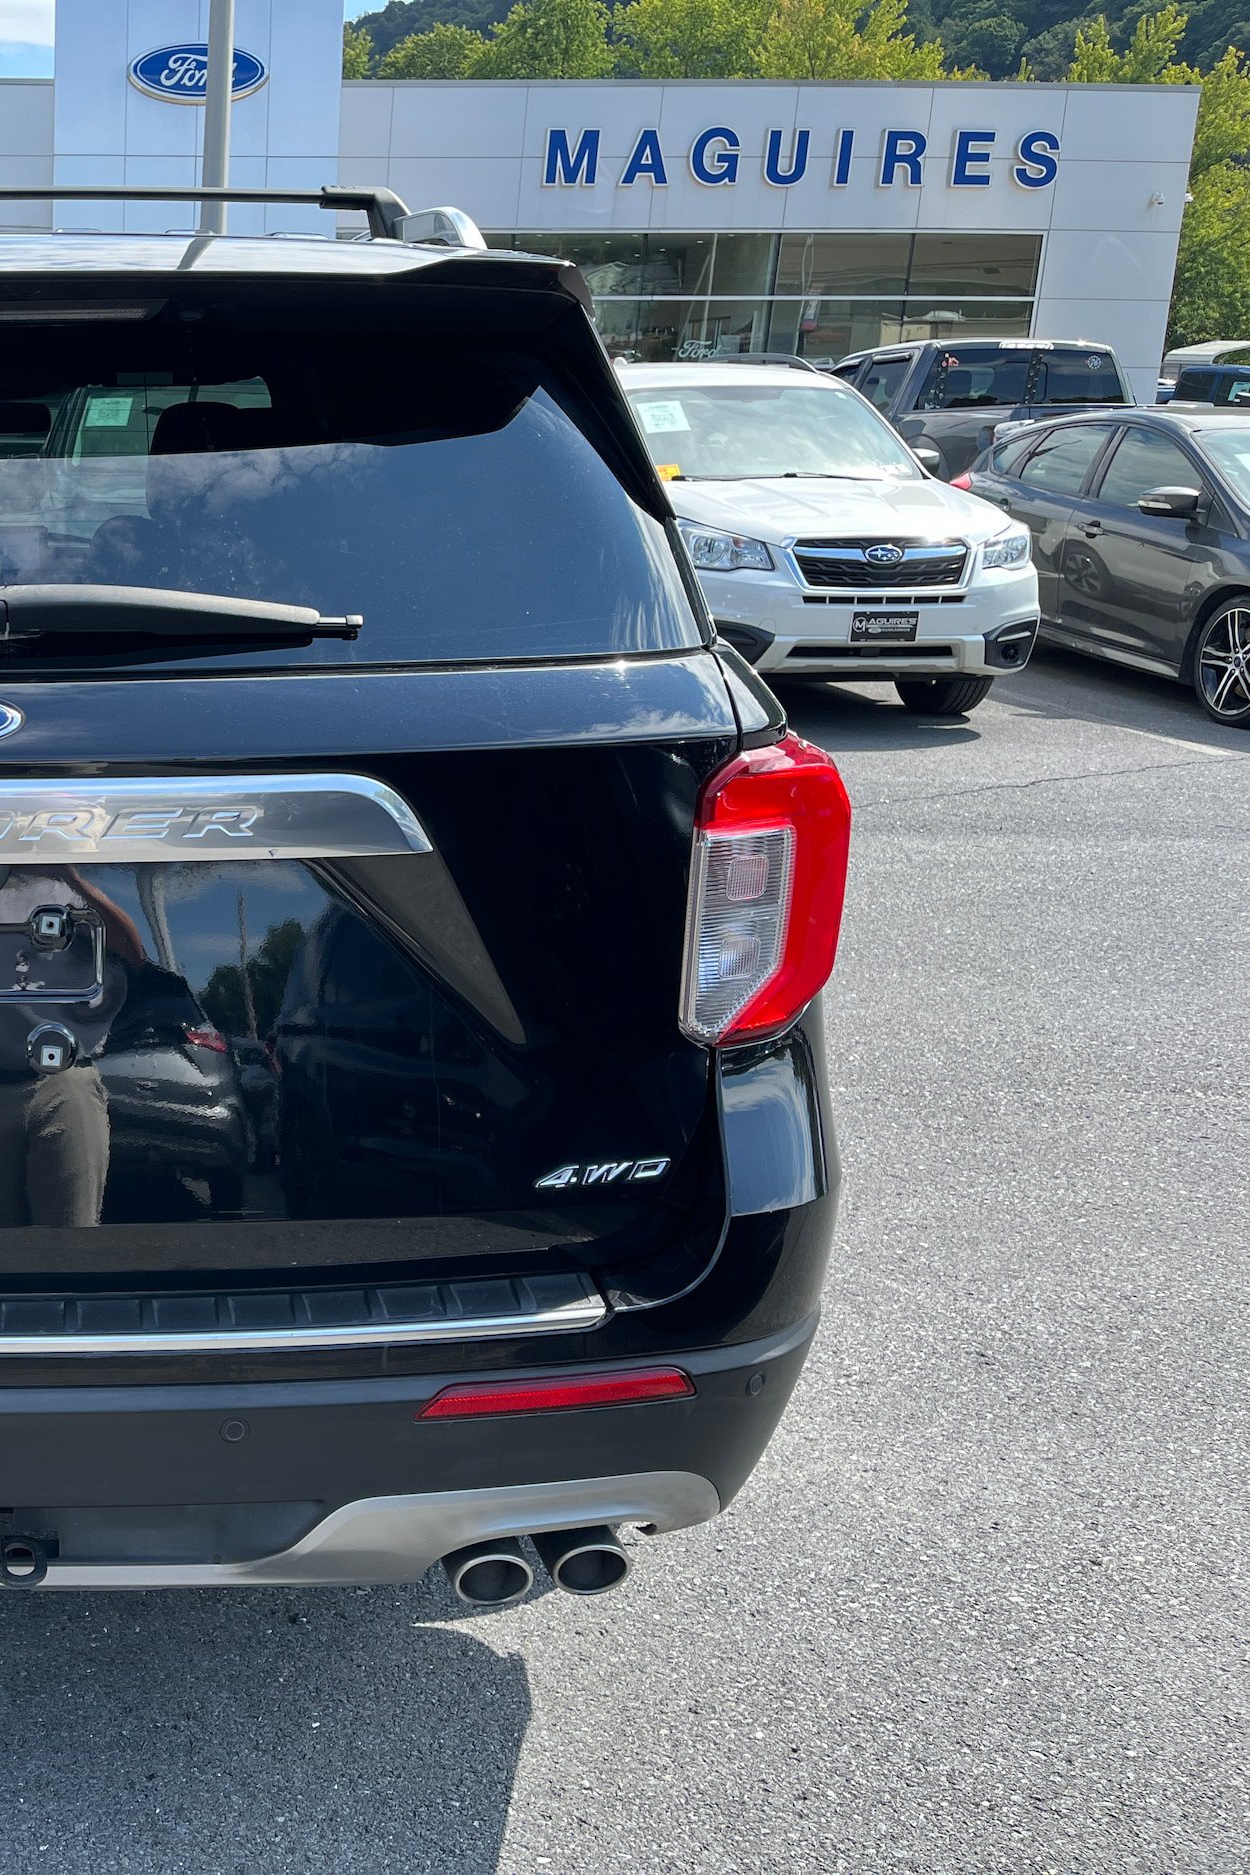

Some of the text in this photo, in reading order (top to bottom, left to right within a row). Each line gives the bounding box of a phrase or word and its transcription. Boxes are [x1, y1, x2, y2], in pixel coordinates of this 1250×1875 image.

[160, 53, 238, 87] For
[543, 128, 1062, 189] MAGUIRES
[678, 340, 722, 358] Ford
[534, 1157, 671, 1189] 4WD
